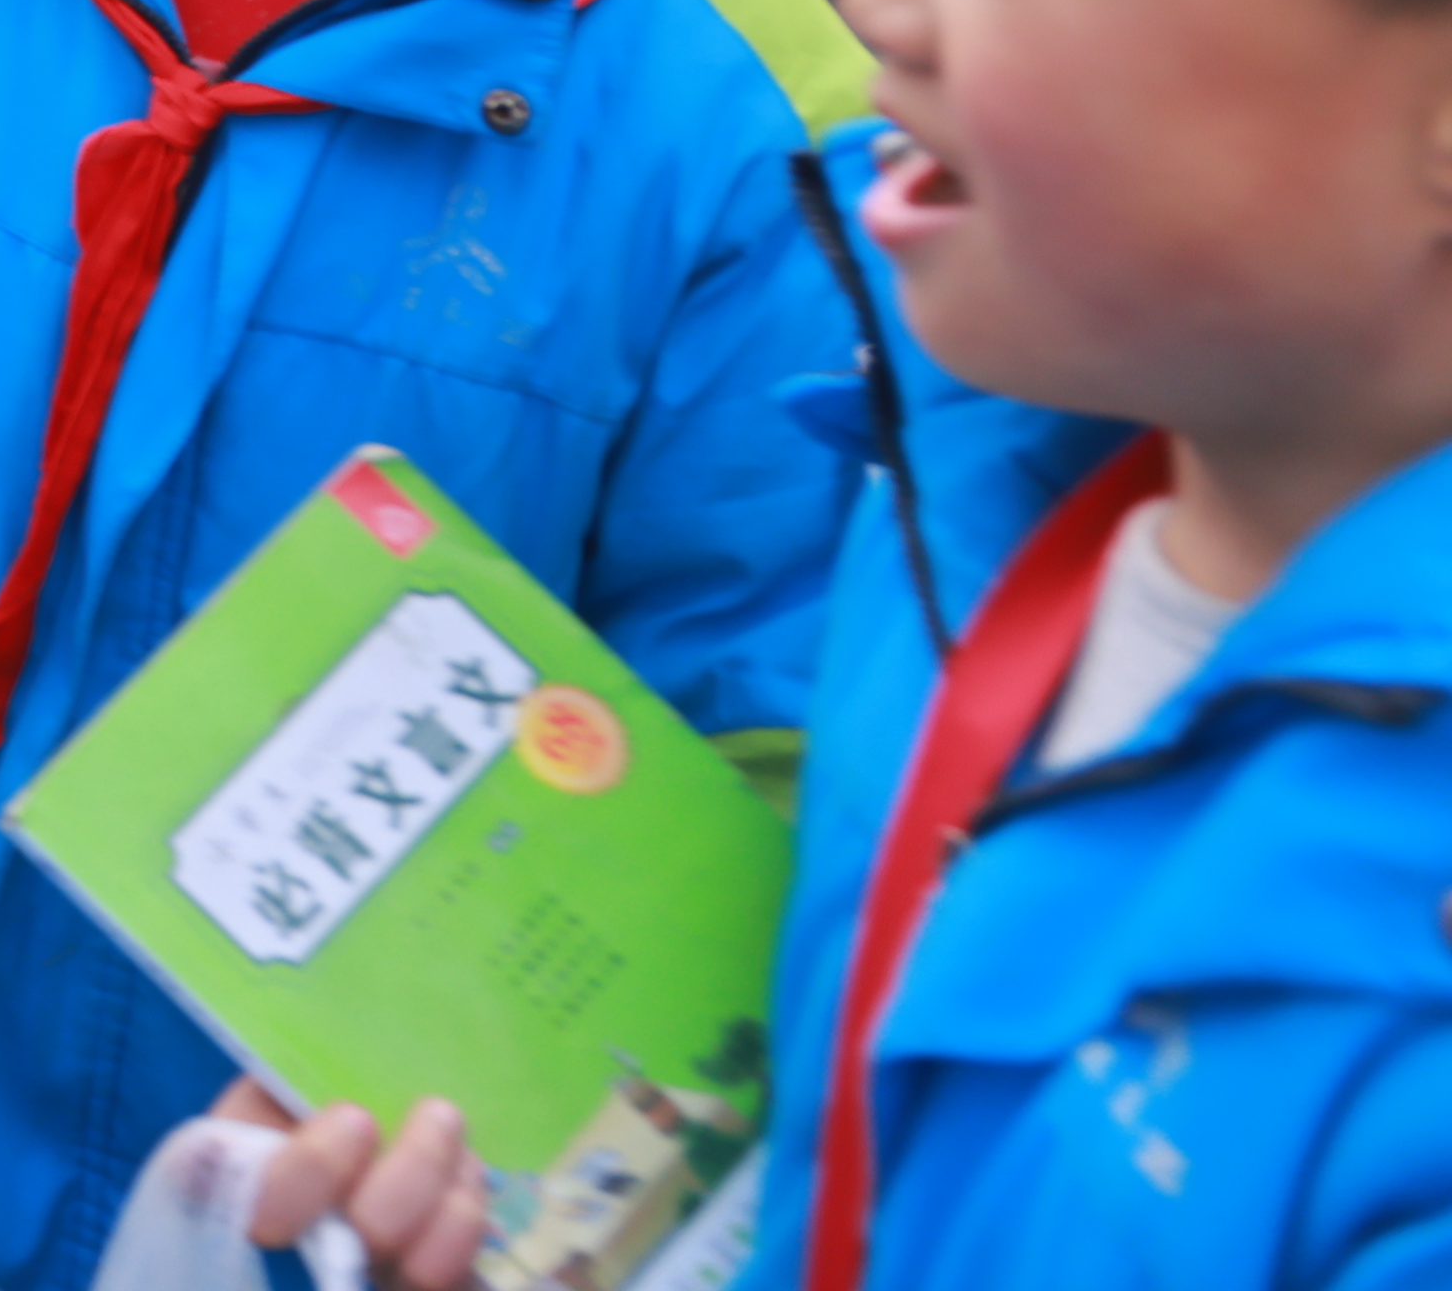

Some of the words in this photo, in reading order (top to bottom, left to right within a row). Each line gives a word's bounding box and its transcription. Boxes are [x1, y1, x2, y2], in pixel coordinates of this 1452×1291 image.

[251, 655, 518, 942] 必背文言文
